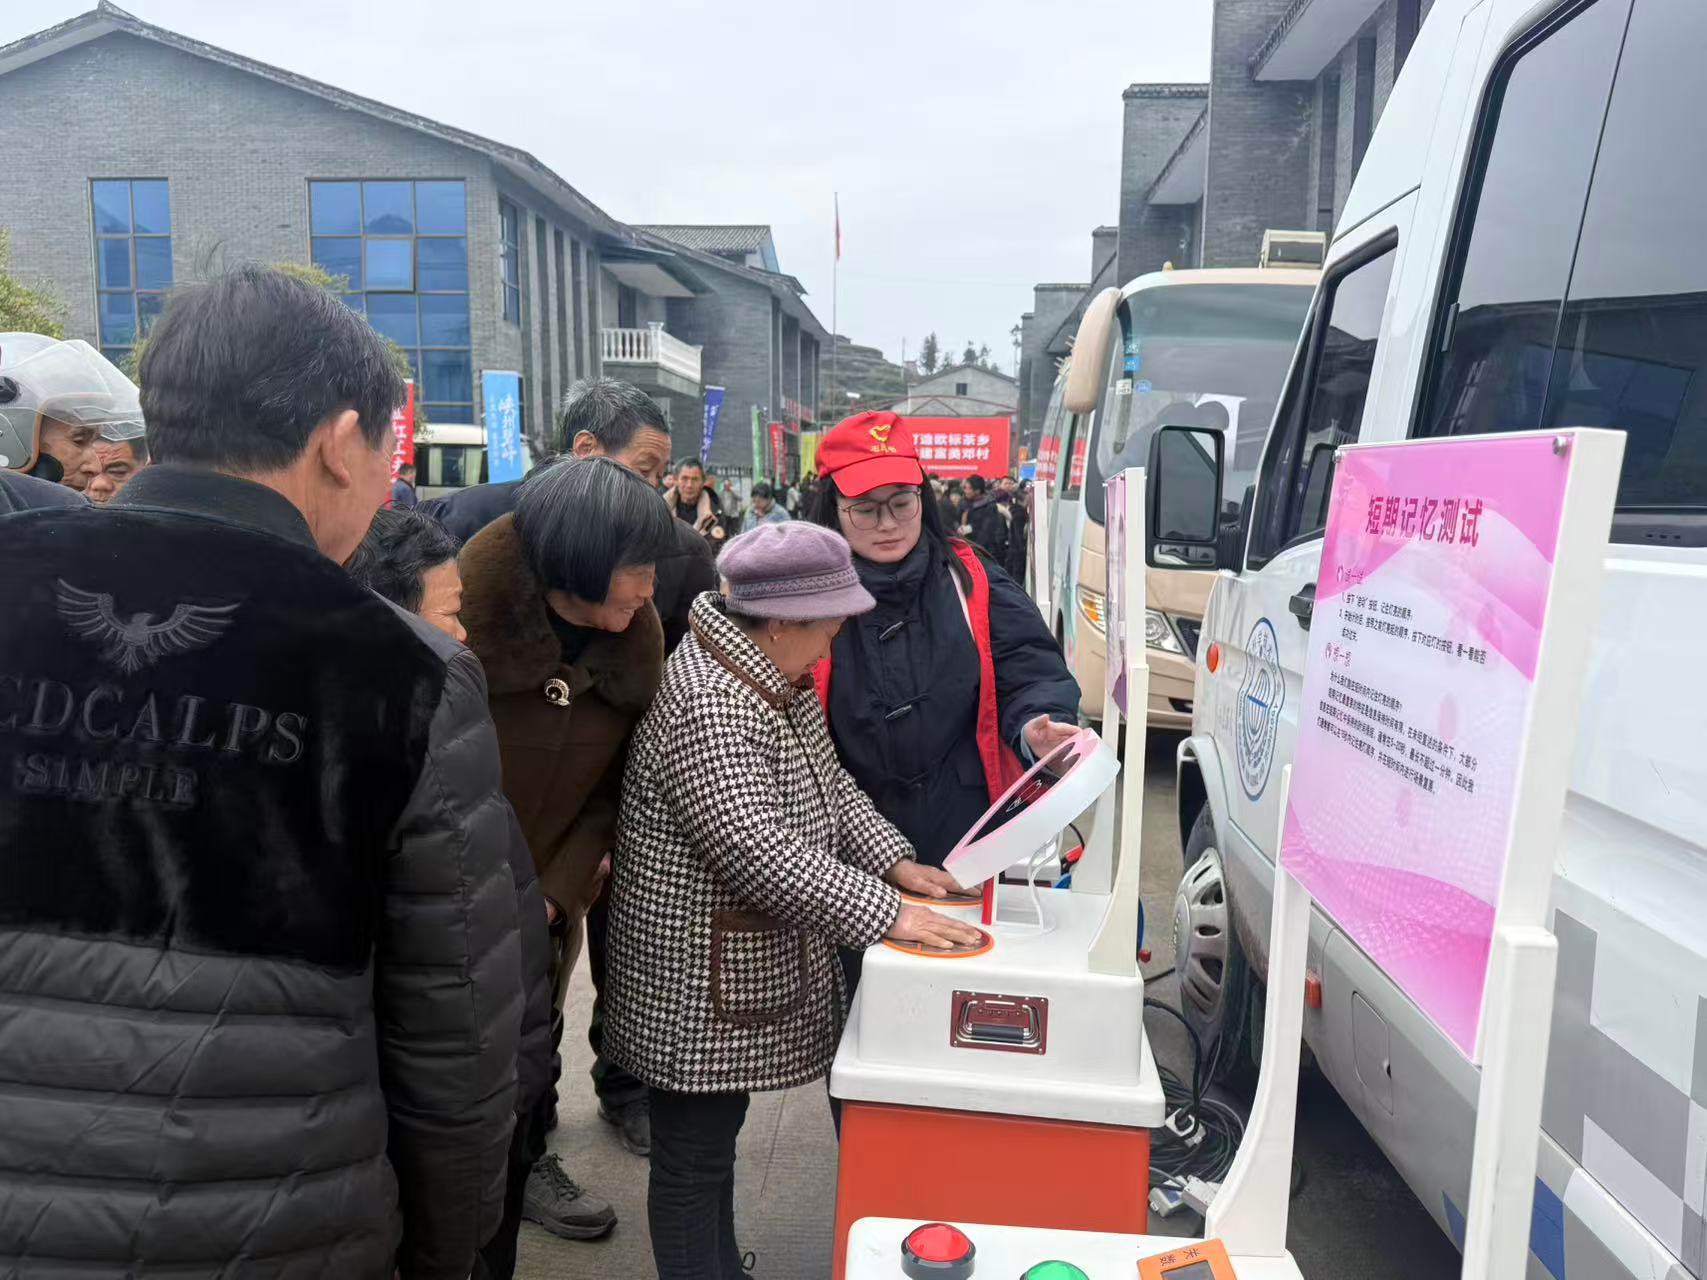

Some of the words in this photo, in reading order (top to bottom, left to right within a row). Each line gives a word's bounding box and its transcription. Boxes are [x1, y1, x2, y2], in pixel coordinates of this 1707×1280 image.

[914, 447, 990, 460] 建富美邓村
[1365, 495, 1483, 547] 短期记忆测试
[1160, 1247, 1201, 1267] 关数
